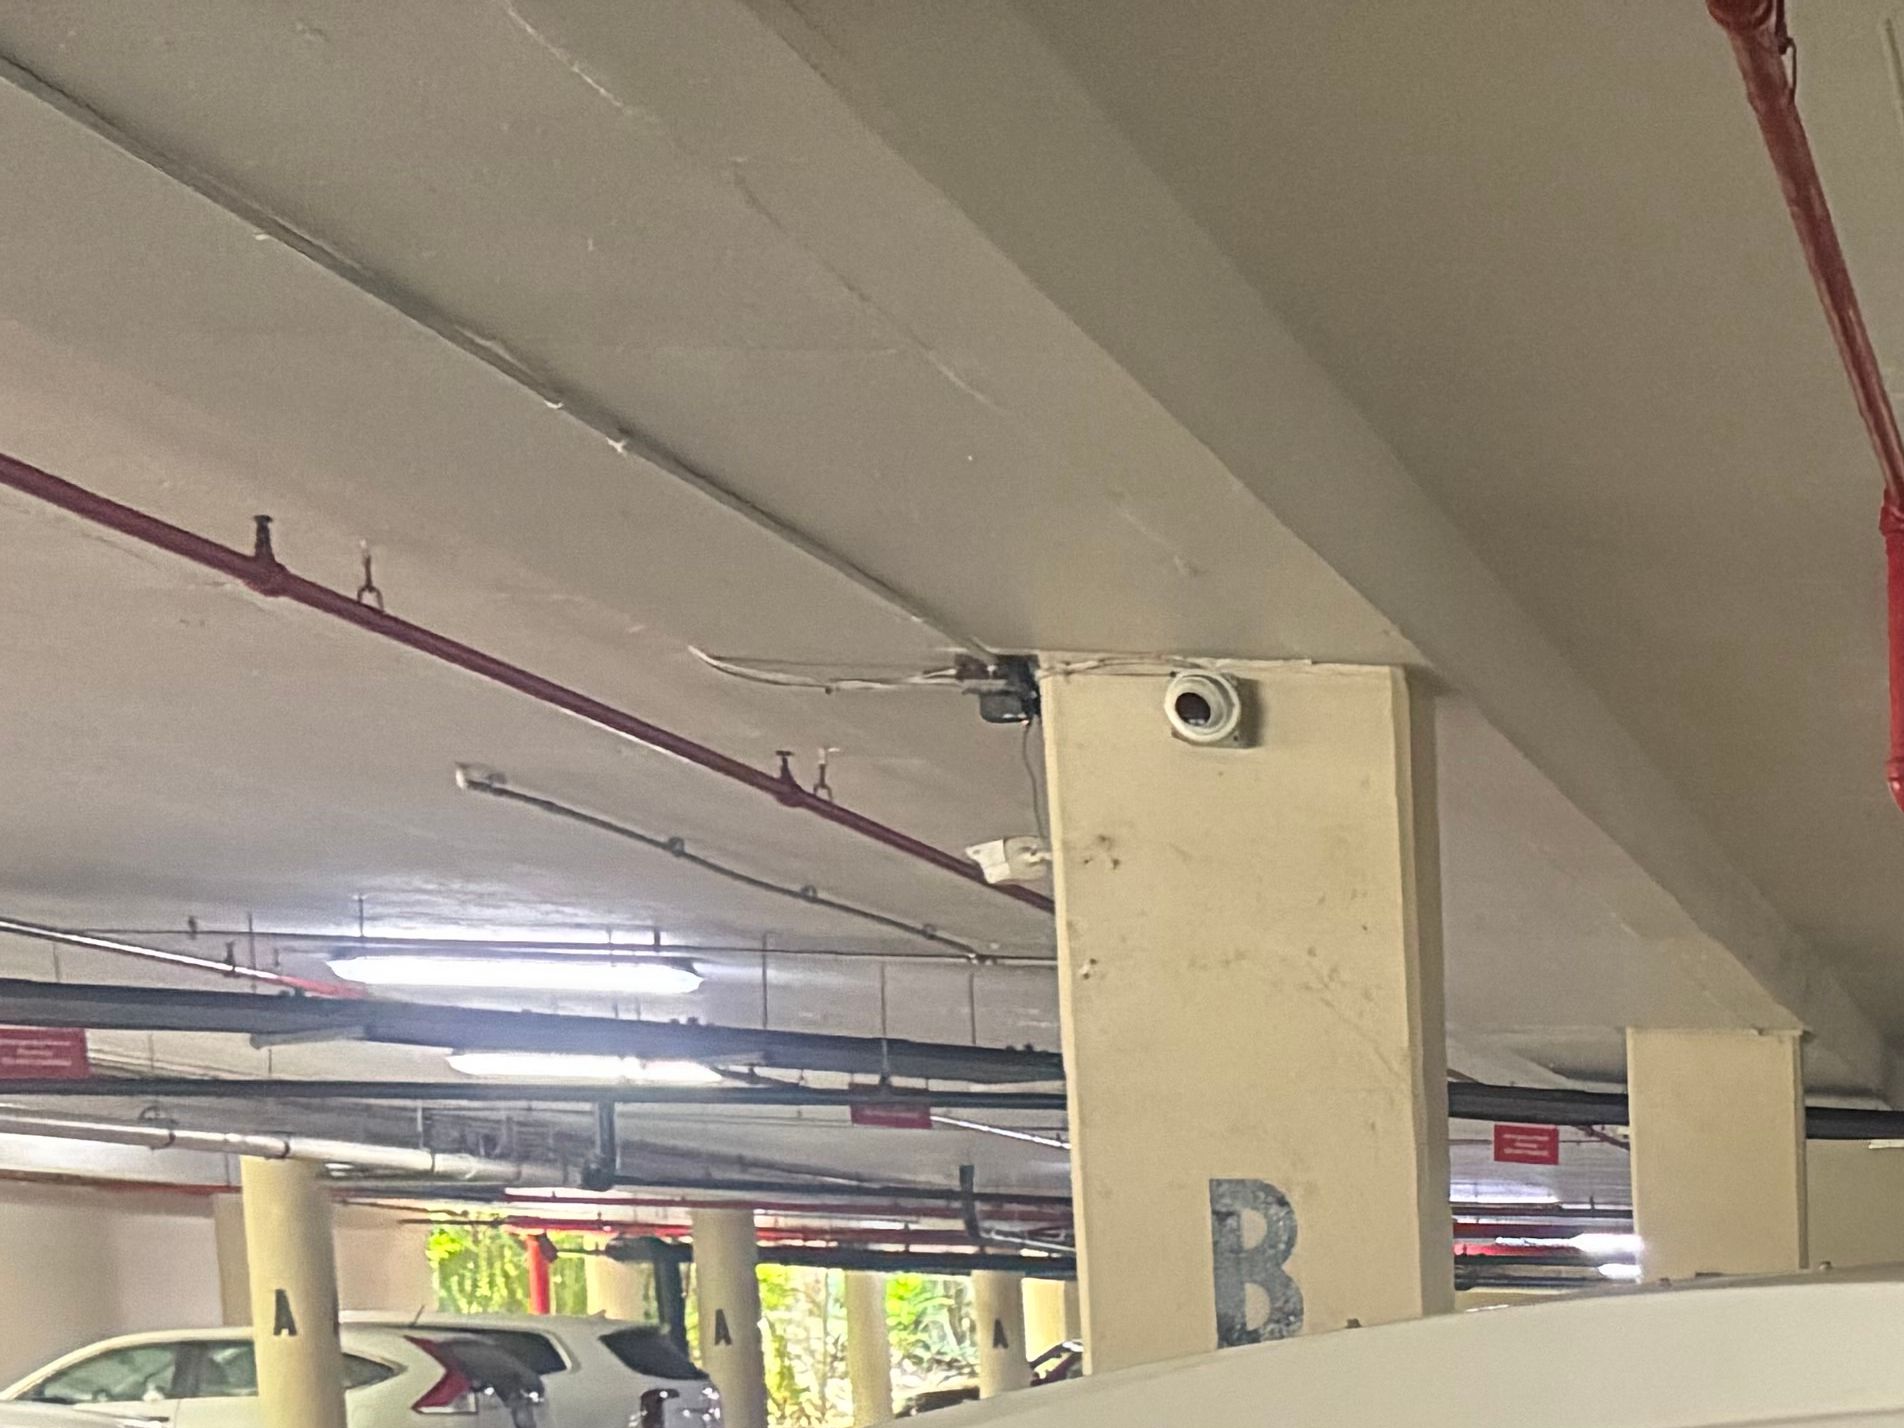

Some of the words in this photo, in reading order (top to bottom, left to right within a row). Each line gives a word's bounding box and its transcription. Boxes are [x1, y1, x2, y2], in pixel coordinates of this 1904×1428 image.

[1209, 1178, 1304, 1349] B
[273, 1288, 297, 1336] A
[714, 1308, 733, 1346] A
[992, 1318, 1009, 1349] A
